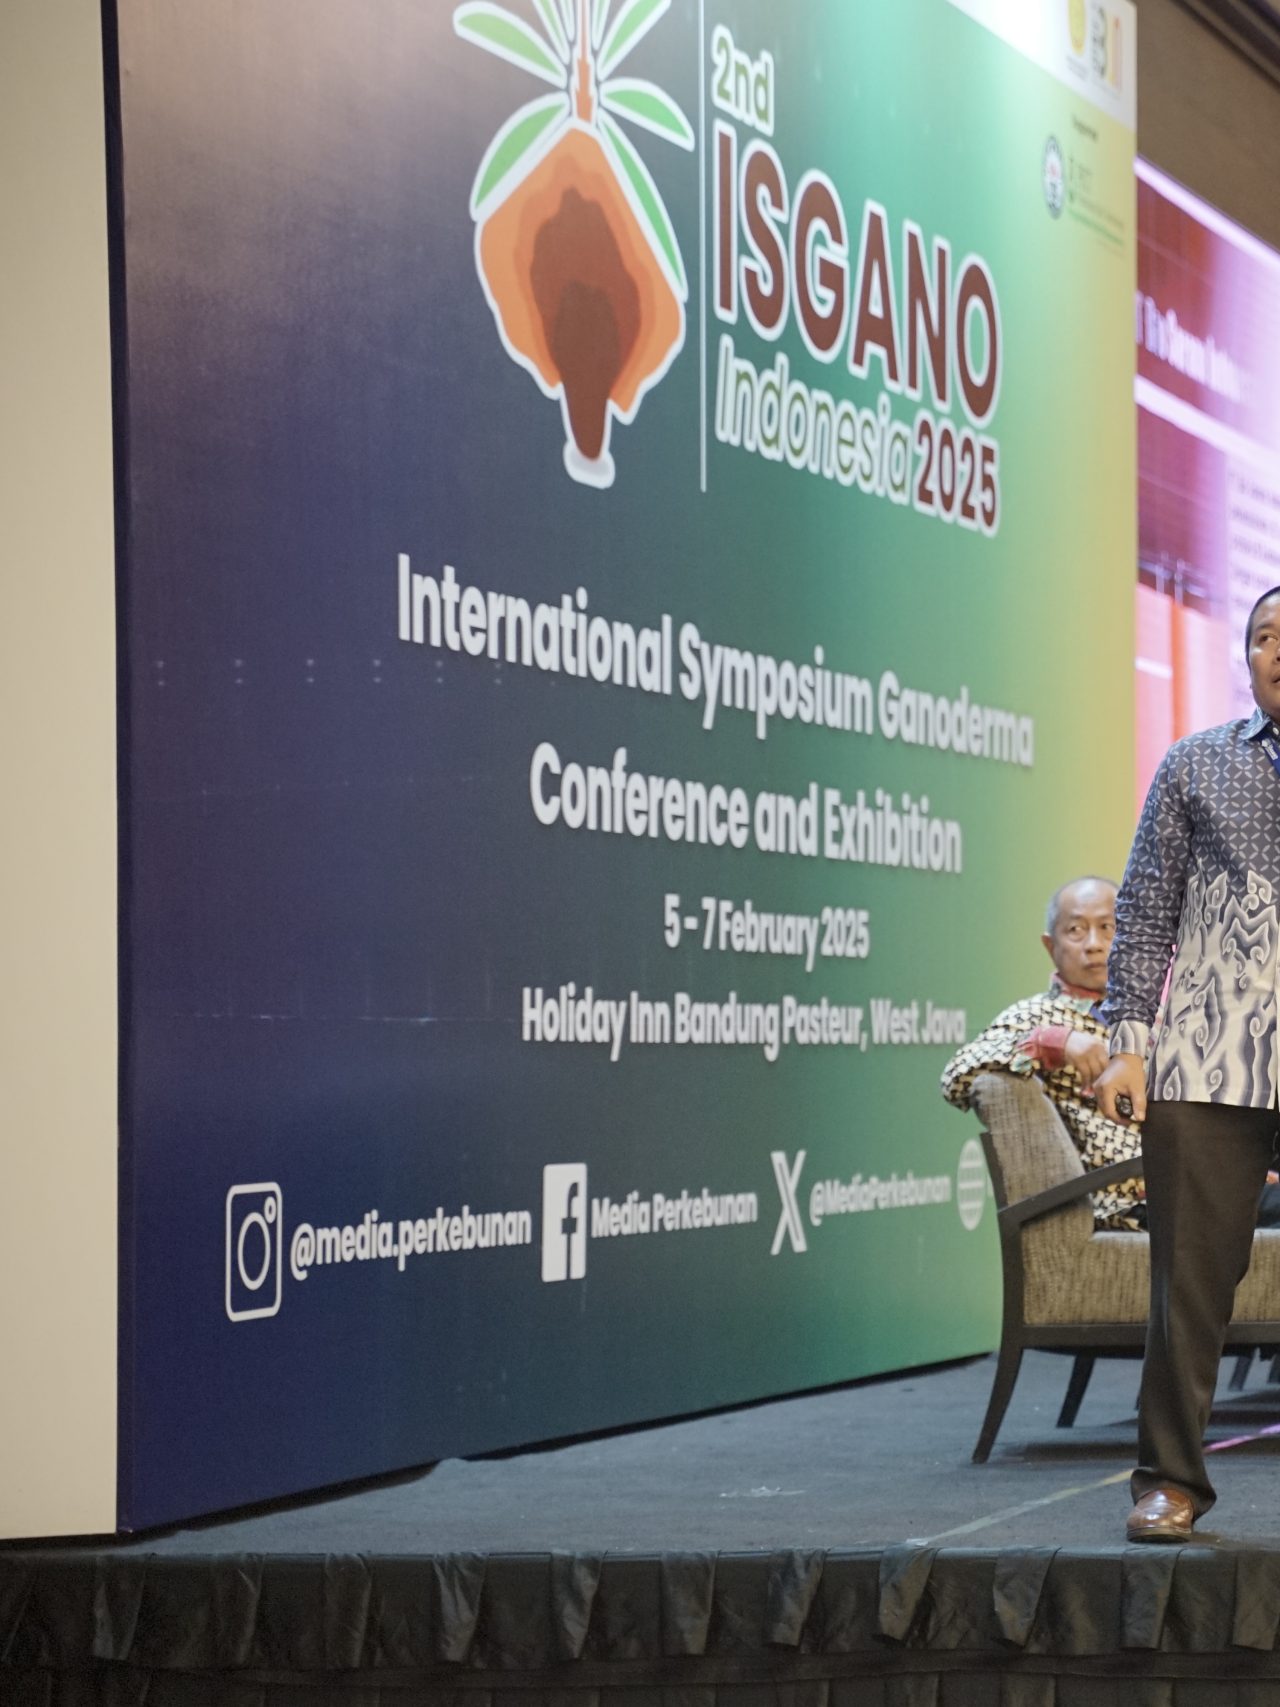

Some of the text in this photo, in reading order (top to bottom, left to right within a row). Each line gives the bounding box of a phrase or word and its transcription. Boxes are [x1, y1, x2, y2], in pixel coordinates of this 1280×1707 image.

[713, 24, 774, 135] 2nd
[714, 119, 1001, 428] ISGANO
[716, 335, 998, 537] Indonesia 2025
[398, 553, 1035, 767] International Symposium Ganoderma
[530, 742, 962, 874] Conference and Exhibition
[664, 893, 681, 948] 5
[702, 897, 716, 950] 7
[719, 900, 819, 973] February
[821, 907, 870, 958] 2025
[522, 982, 967, 1062] Holiday Inn Bandung Pasteur, West Java
[290, 1205, 532, 1281] @media.perkebunan
[591, 1188, 758, 1238] Media Perkebunan
[810, 1172, 951, 1226] @MediaPerkebunan
